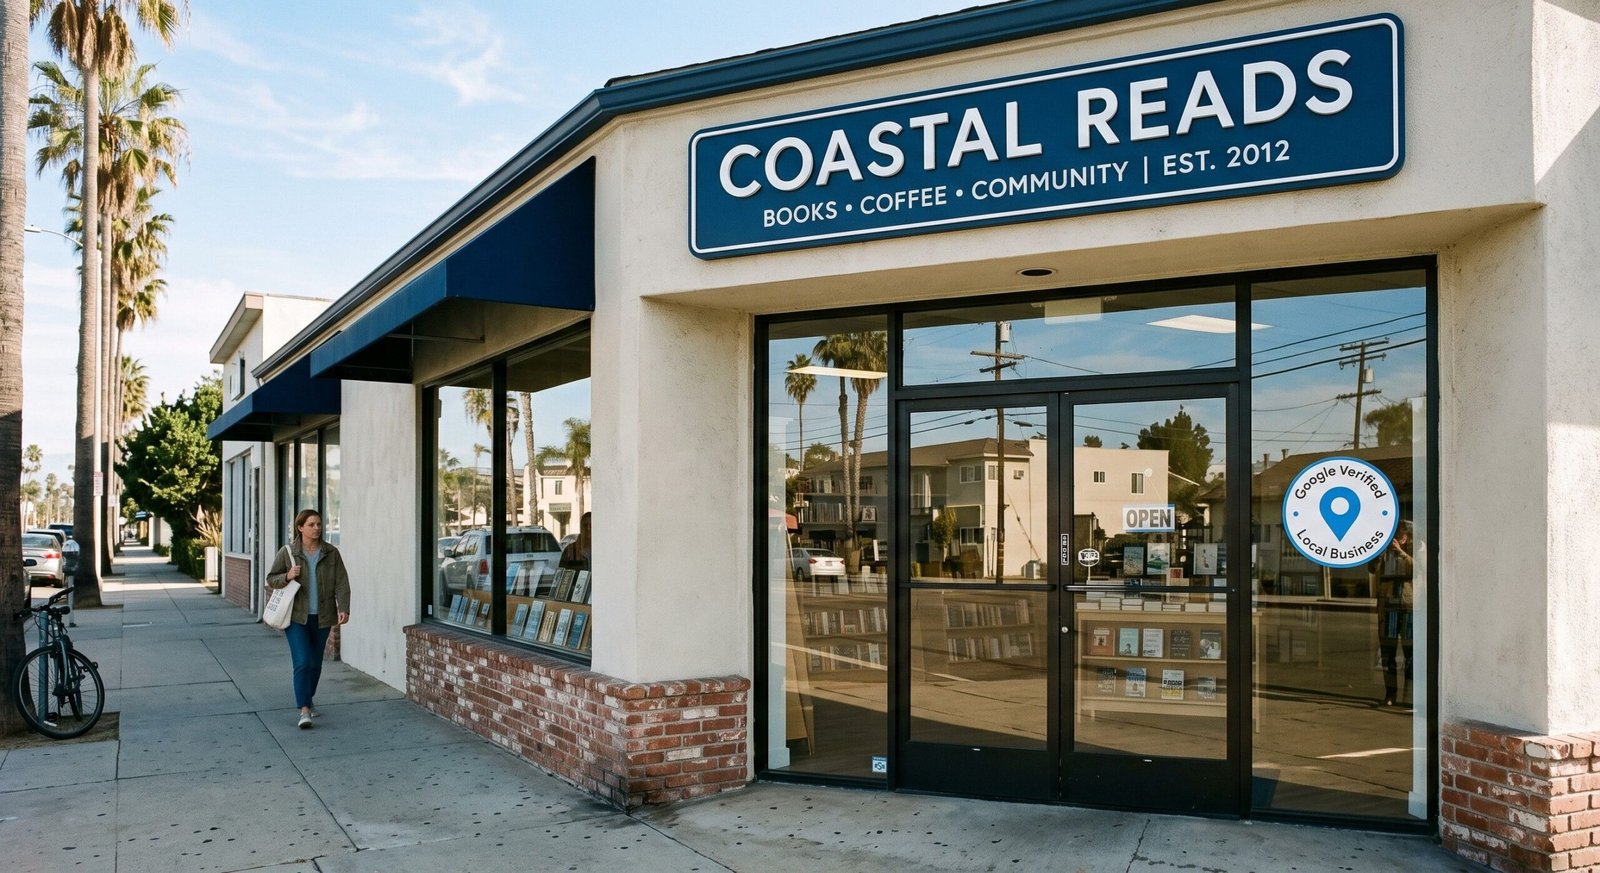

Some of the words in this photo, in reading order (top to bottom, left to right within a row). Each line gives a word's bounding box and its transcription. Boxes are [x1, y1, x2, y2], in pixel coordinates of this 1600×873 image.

[719, 101, 1043, 198] COASTAL
[1077, 49, 1354, 148] READS
[763, 200, 838, 228] BOOKS
[860, 185, 947, 215] COFFEE
[971, 160, 1129, 200] COMMUNITY
[1163, 149, 1216, 176] EST.
[1226, 139, 1290, 168] 2012
[1294, 466, 1337, 500] Google
[1339, 464, 1387, 500] Verified
[1126, 508, 1172, 528] OPEN
[1296, 528, 1328, 557] Local
[1330, 530, 1384, 560] Business
